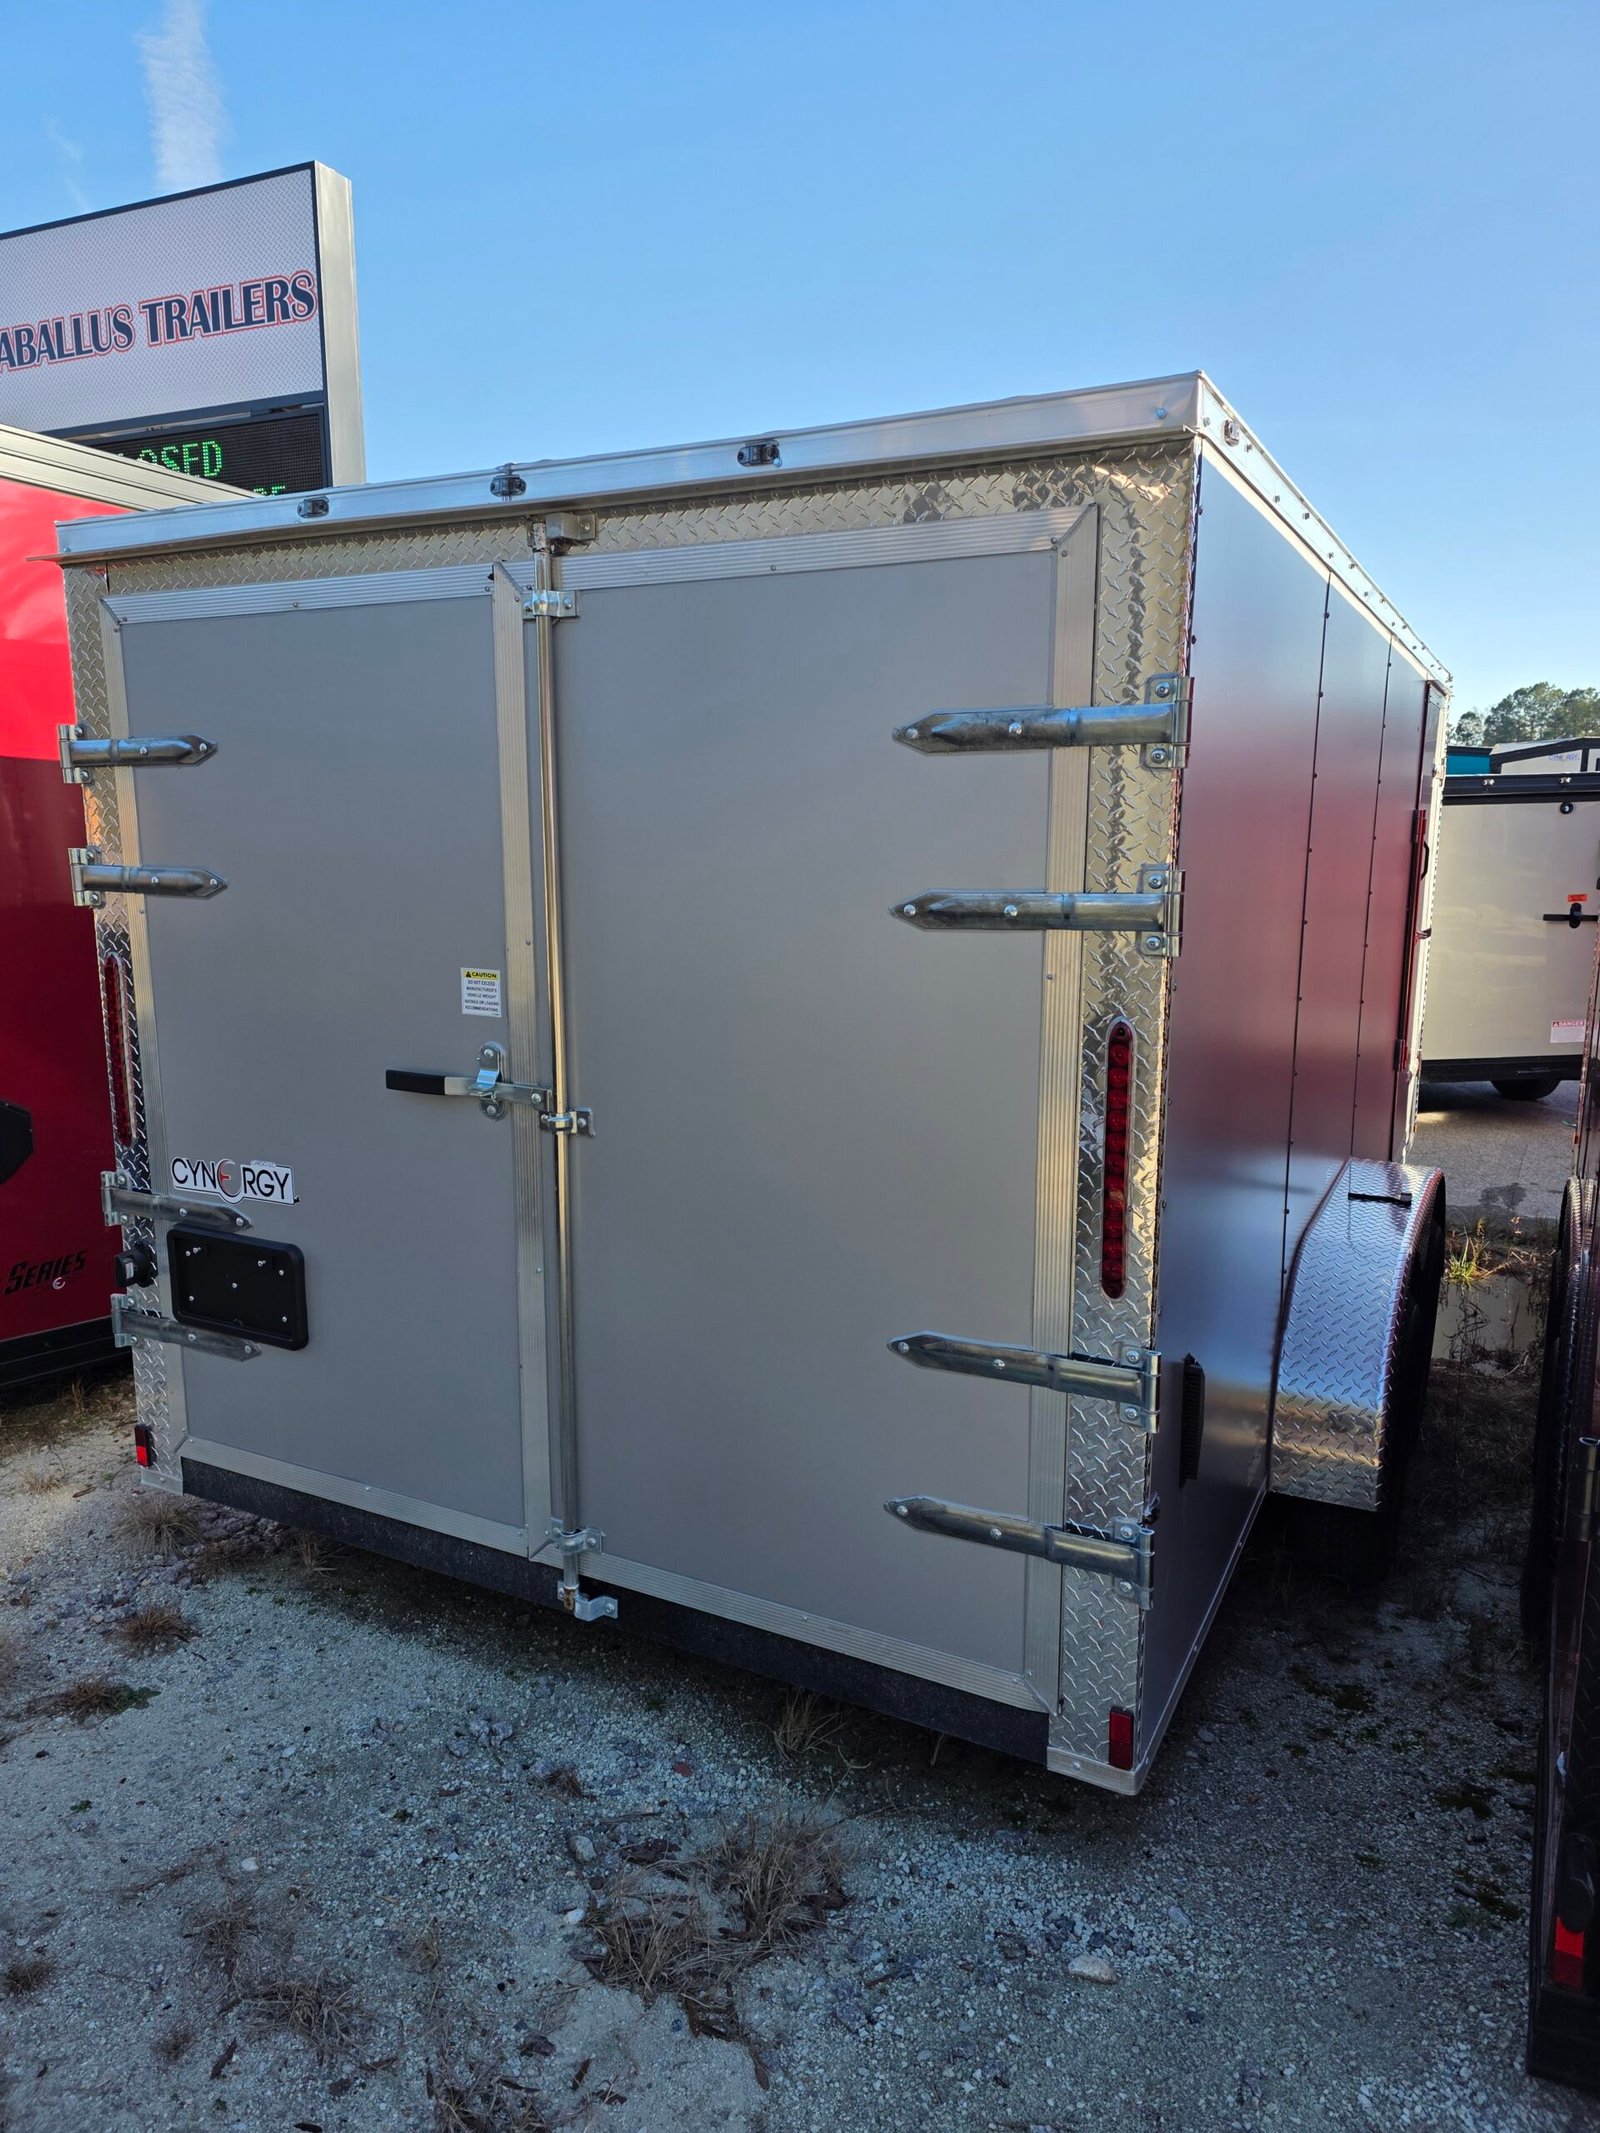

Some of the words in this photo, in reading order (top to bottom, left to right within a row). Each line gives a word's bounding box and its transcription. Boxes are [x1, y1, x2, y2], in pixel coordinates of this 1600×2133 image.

[0, 304, 135, 371] ABALLUS
[140, 270, 317, 346] TRAILERS
[117, 440, 223, 477] OSED
[172, 1157, 290, 1200] CYNERGY
[3, 1248, 88, 1295] SERIES
